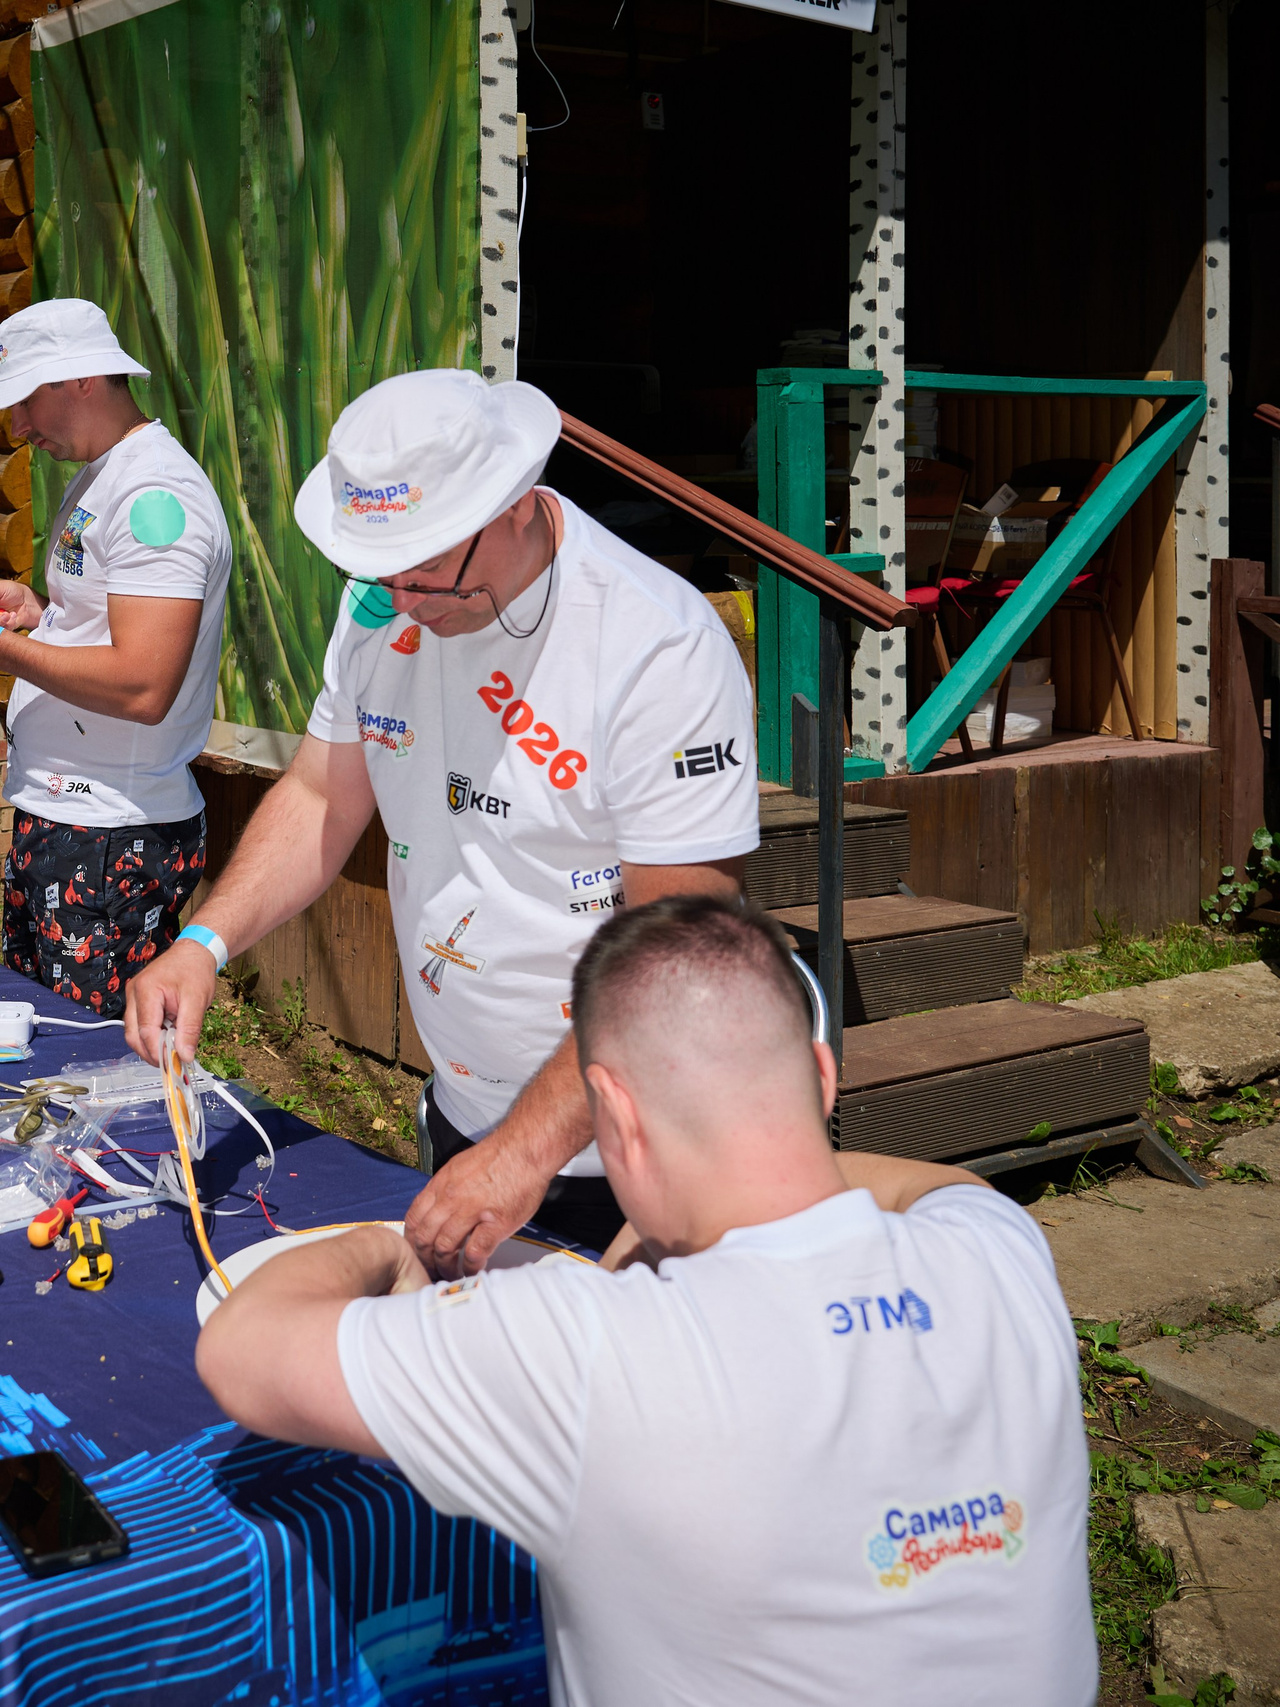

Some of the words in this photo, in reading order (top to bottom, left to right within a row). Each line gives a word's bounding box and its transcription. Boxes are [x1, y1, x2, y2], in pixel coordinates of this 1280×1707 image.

[344, 482, 409, 501] Самара
[365, 515, 389, 523] 2026
[357, 705, 407, 736] Самара
[477, 670, 587, 790] 2026
[65, 782, 92, 794] ЭРА
[569, 891, 625, 913] STEKK
[61, 949, 86, 957] adidas
[825, 1294, 913, 1335] ЭТМ
[885, 1492, 1005, 1540] Самара
